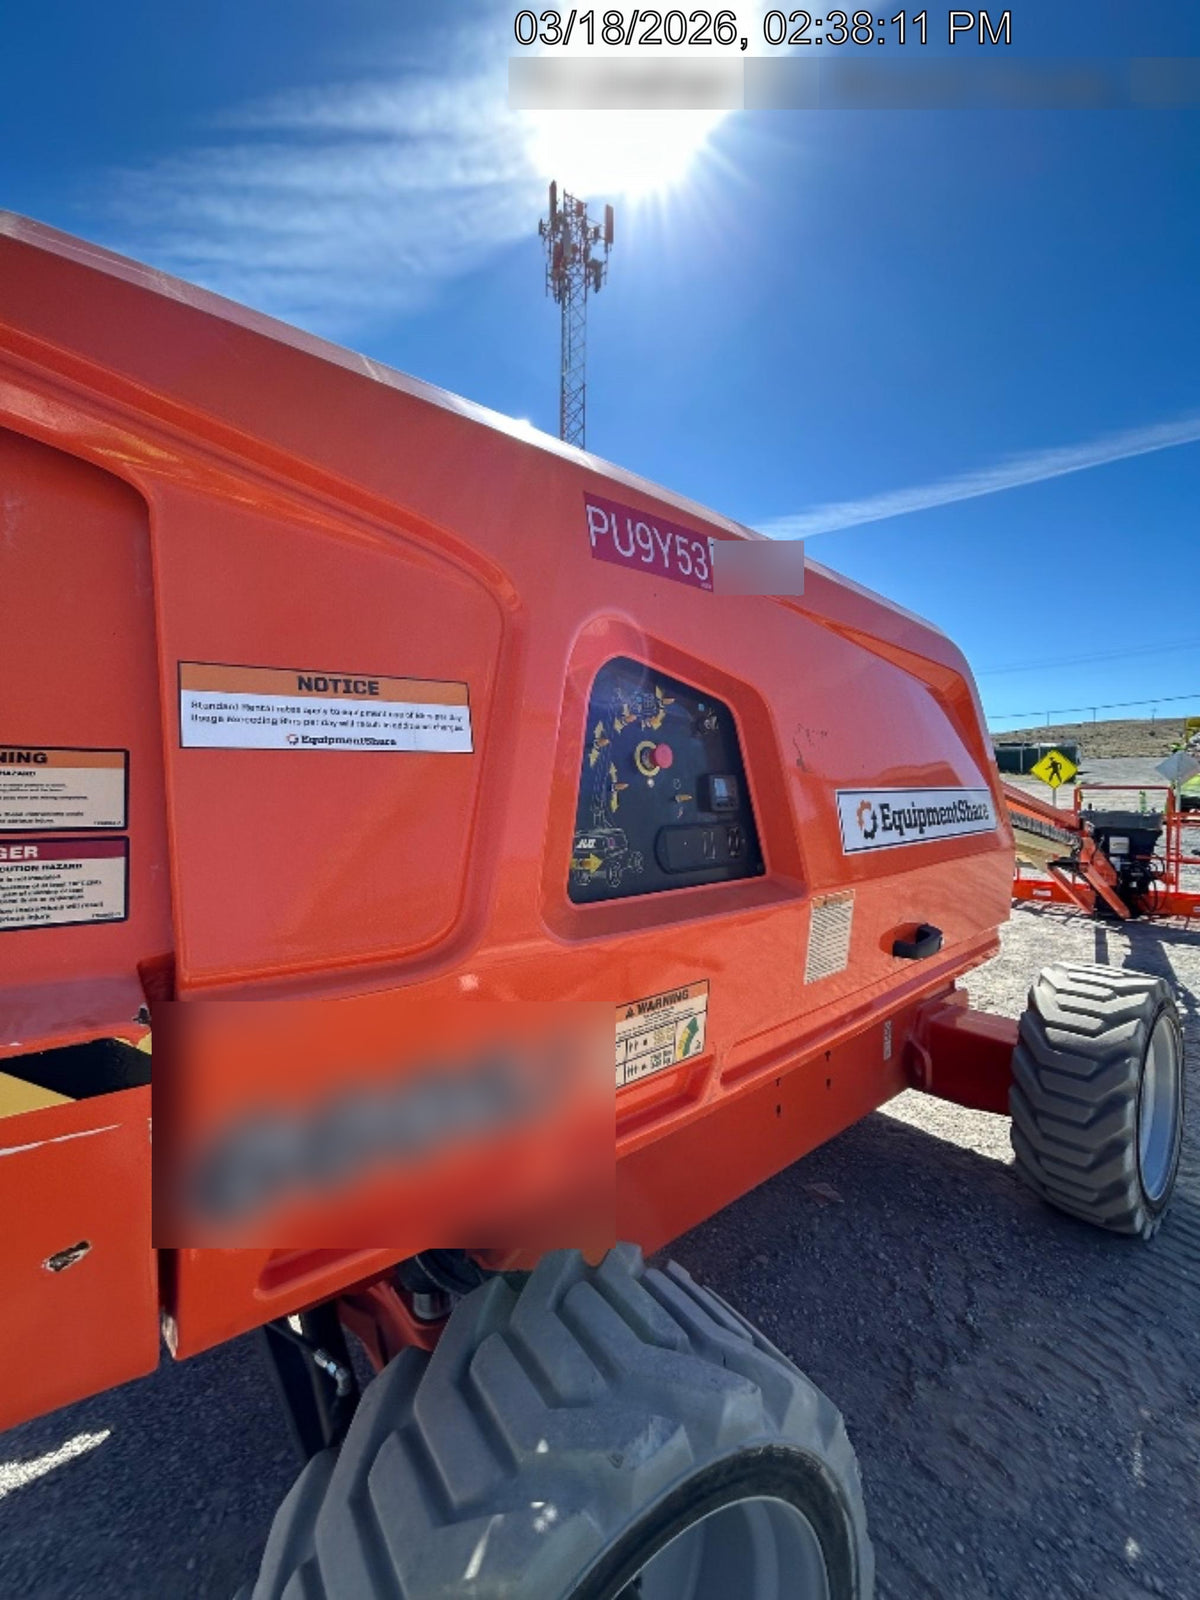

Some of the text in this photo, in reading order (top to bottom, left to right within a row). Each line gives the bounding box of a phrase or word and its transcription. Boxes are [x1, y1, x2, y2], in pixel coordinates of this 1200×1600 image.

[583, 504, 709, 580] PU9Y53
[297, 675, 380, 696] NOTICE
[879, 799, 990, 837] EquipmentShare
[637, 989, 690, 1014] WARNING
